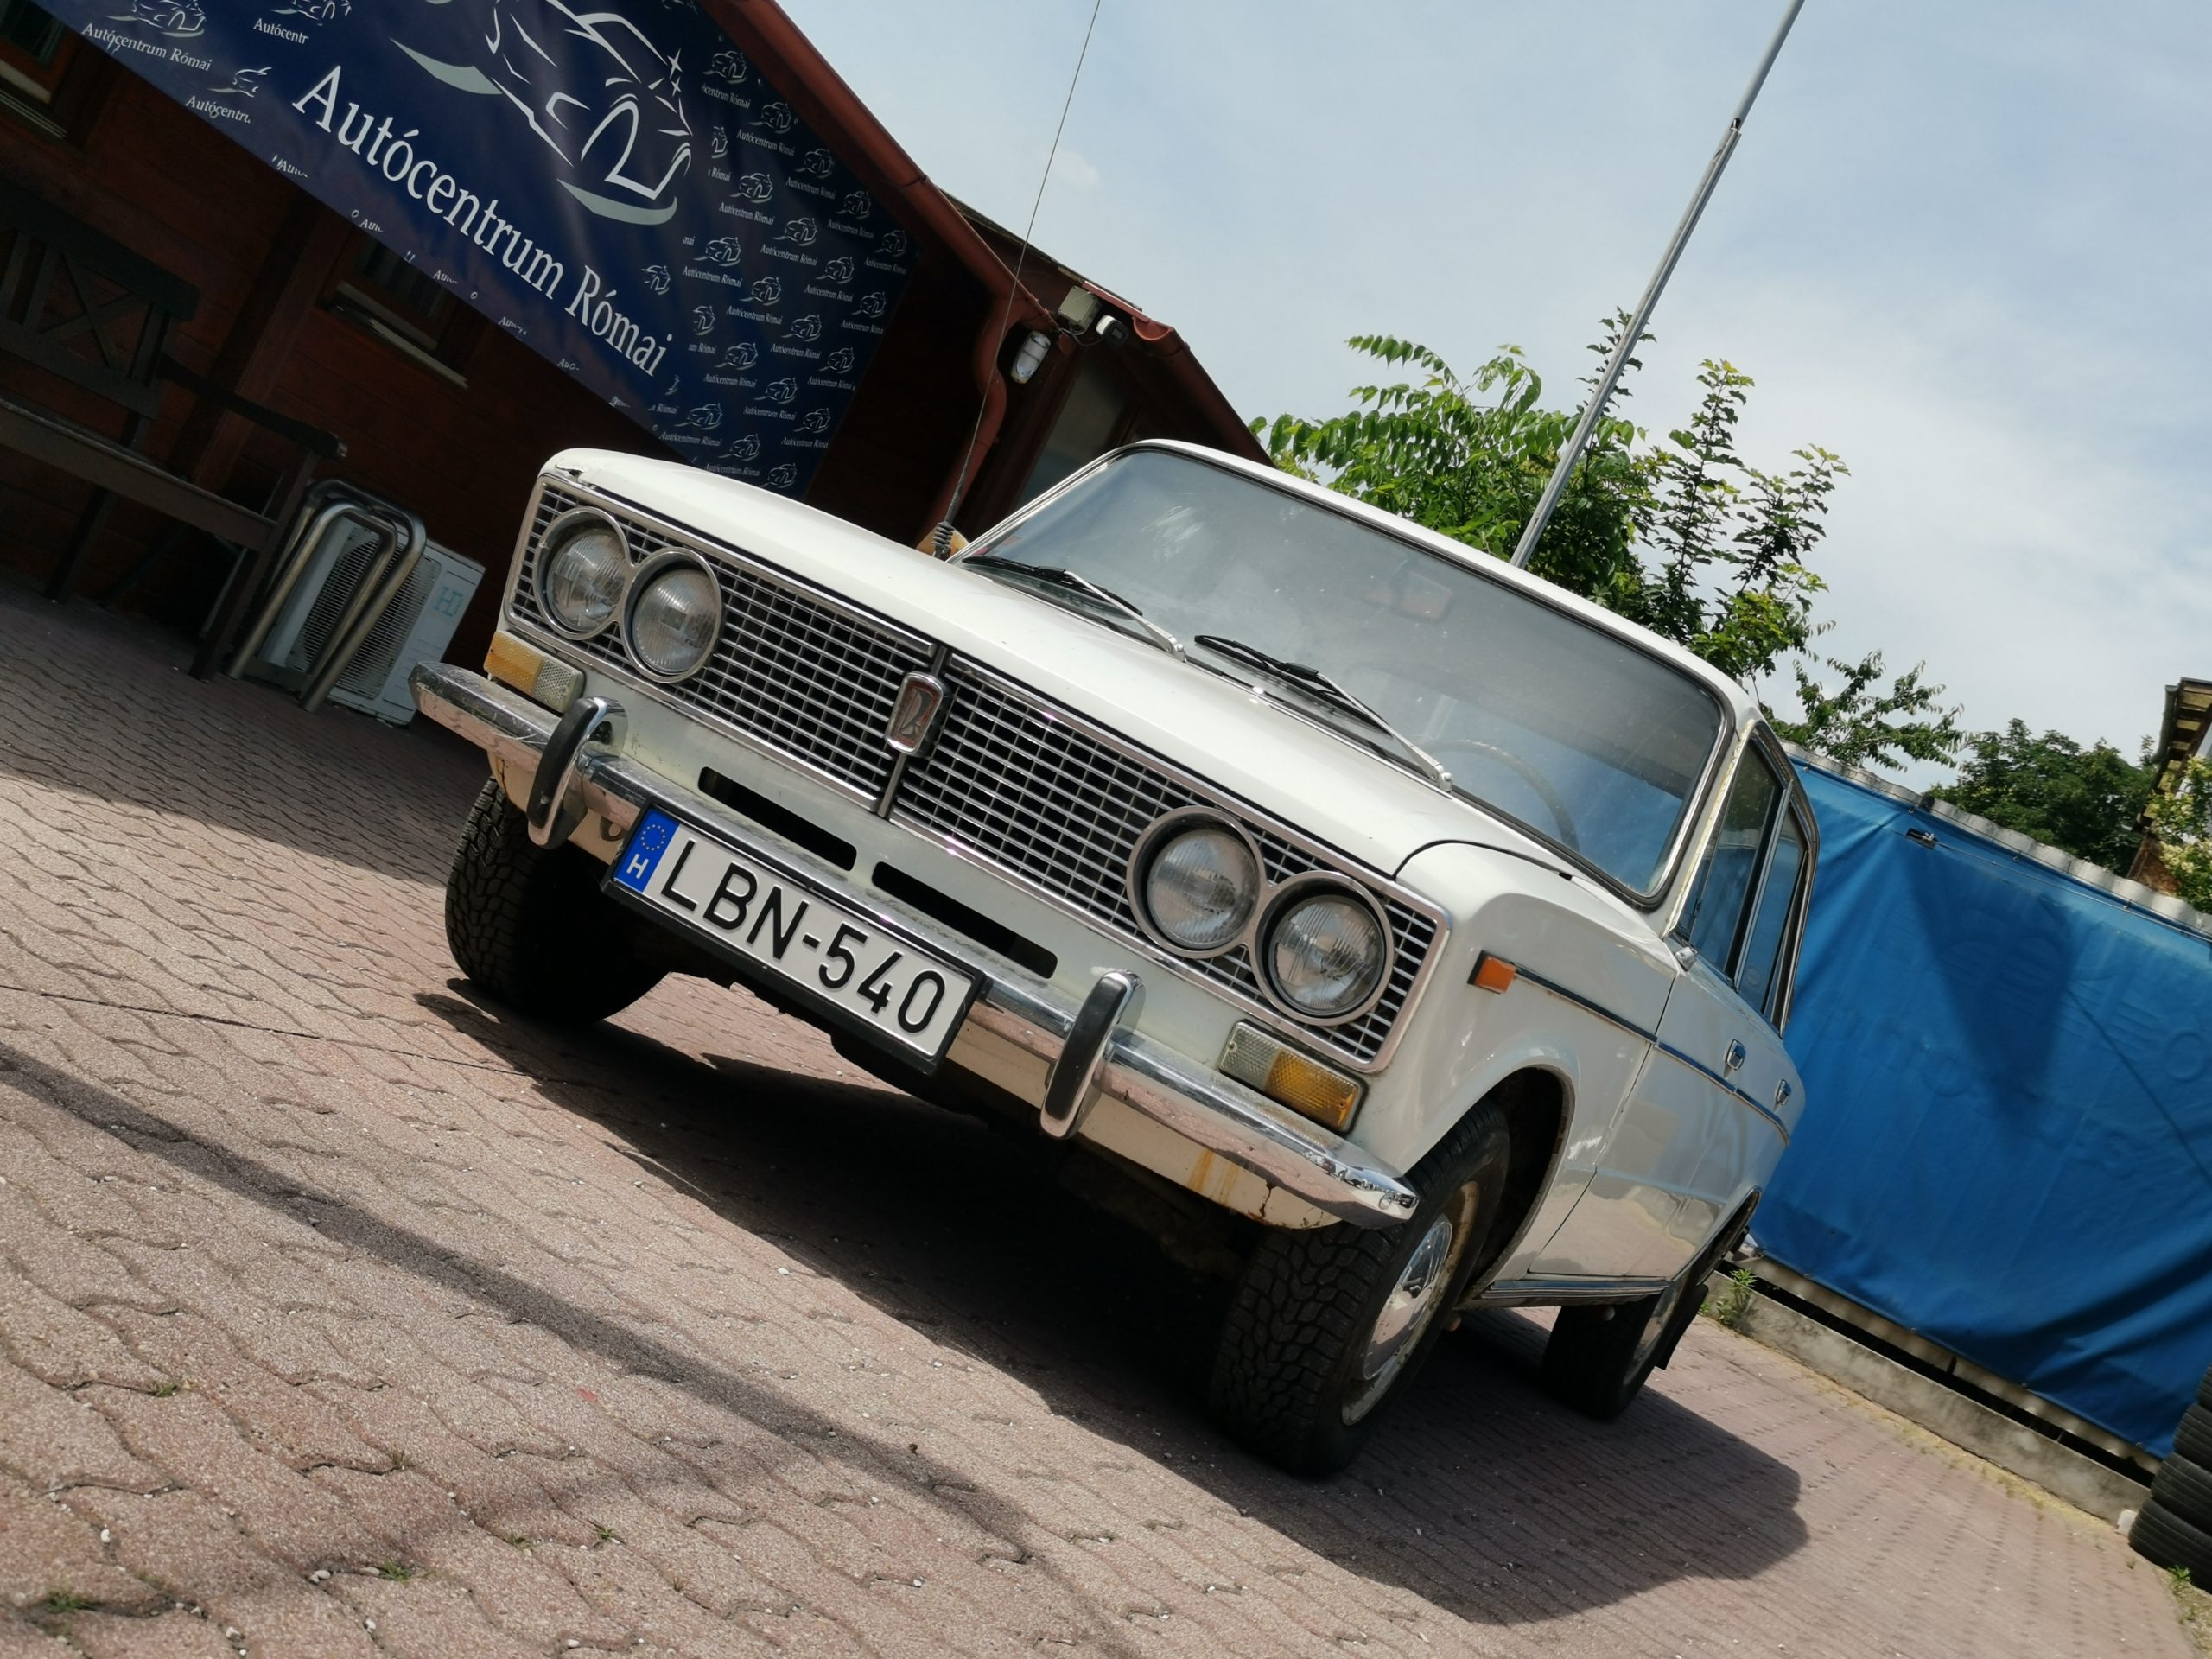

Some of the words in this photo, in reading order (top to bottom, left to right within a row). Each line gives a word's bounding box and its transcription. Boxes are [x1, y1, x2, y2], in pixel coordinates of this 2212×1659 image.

[81, 22, 167, 58] Autócentrum
[170, 48, 213, 71] Római
[292, 65, 564, 300] Autócentrum
[564, 264, 673, 377] Római
[626, 853, 650, 880] H
[660, 839, 946, 1034] LBN-540
